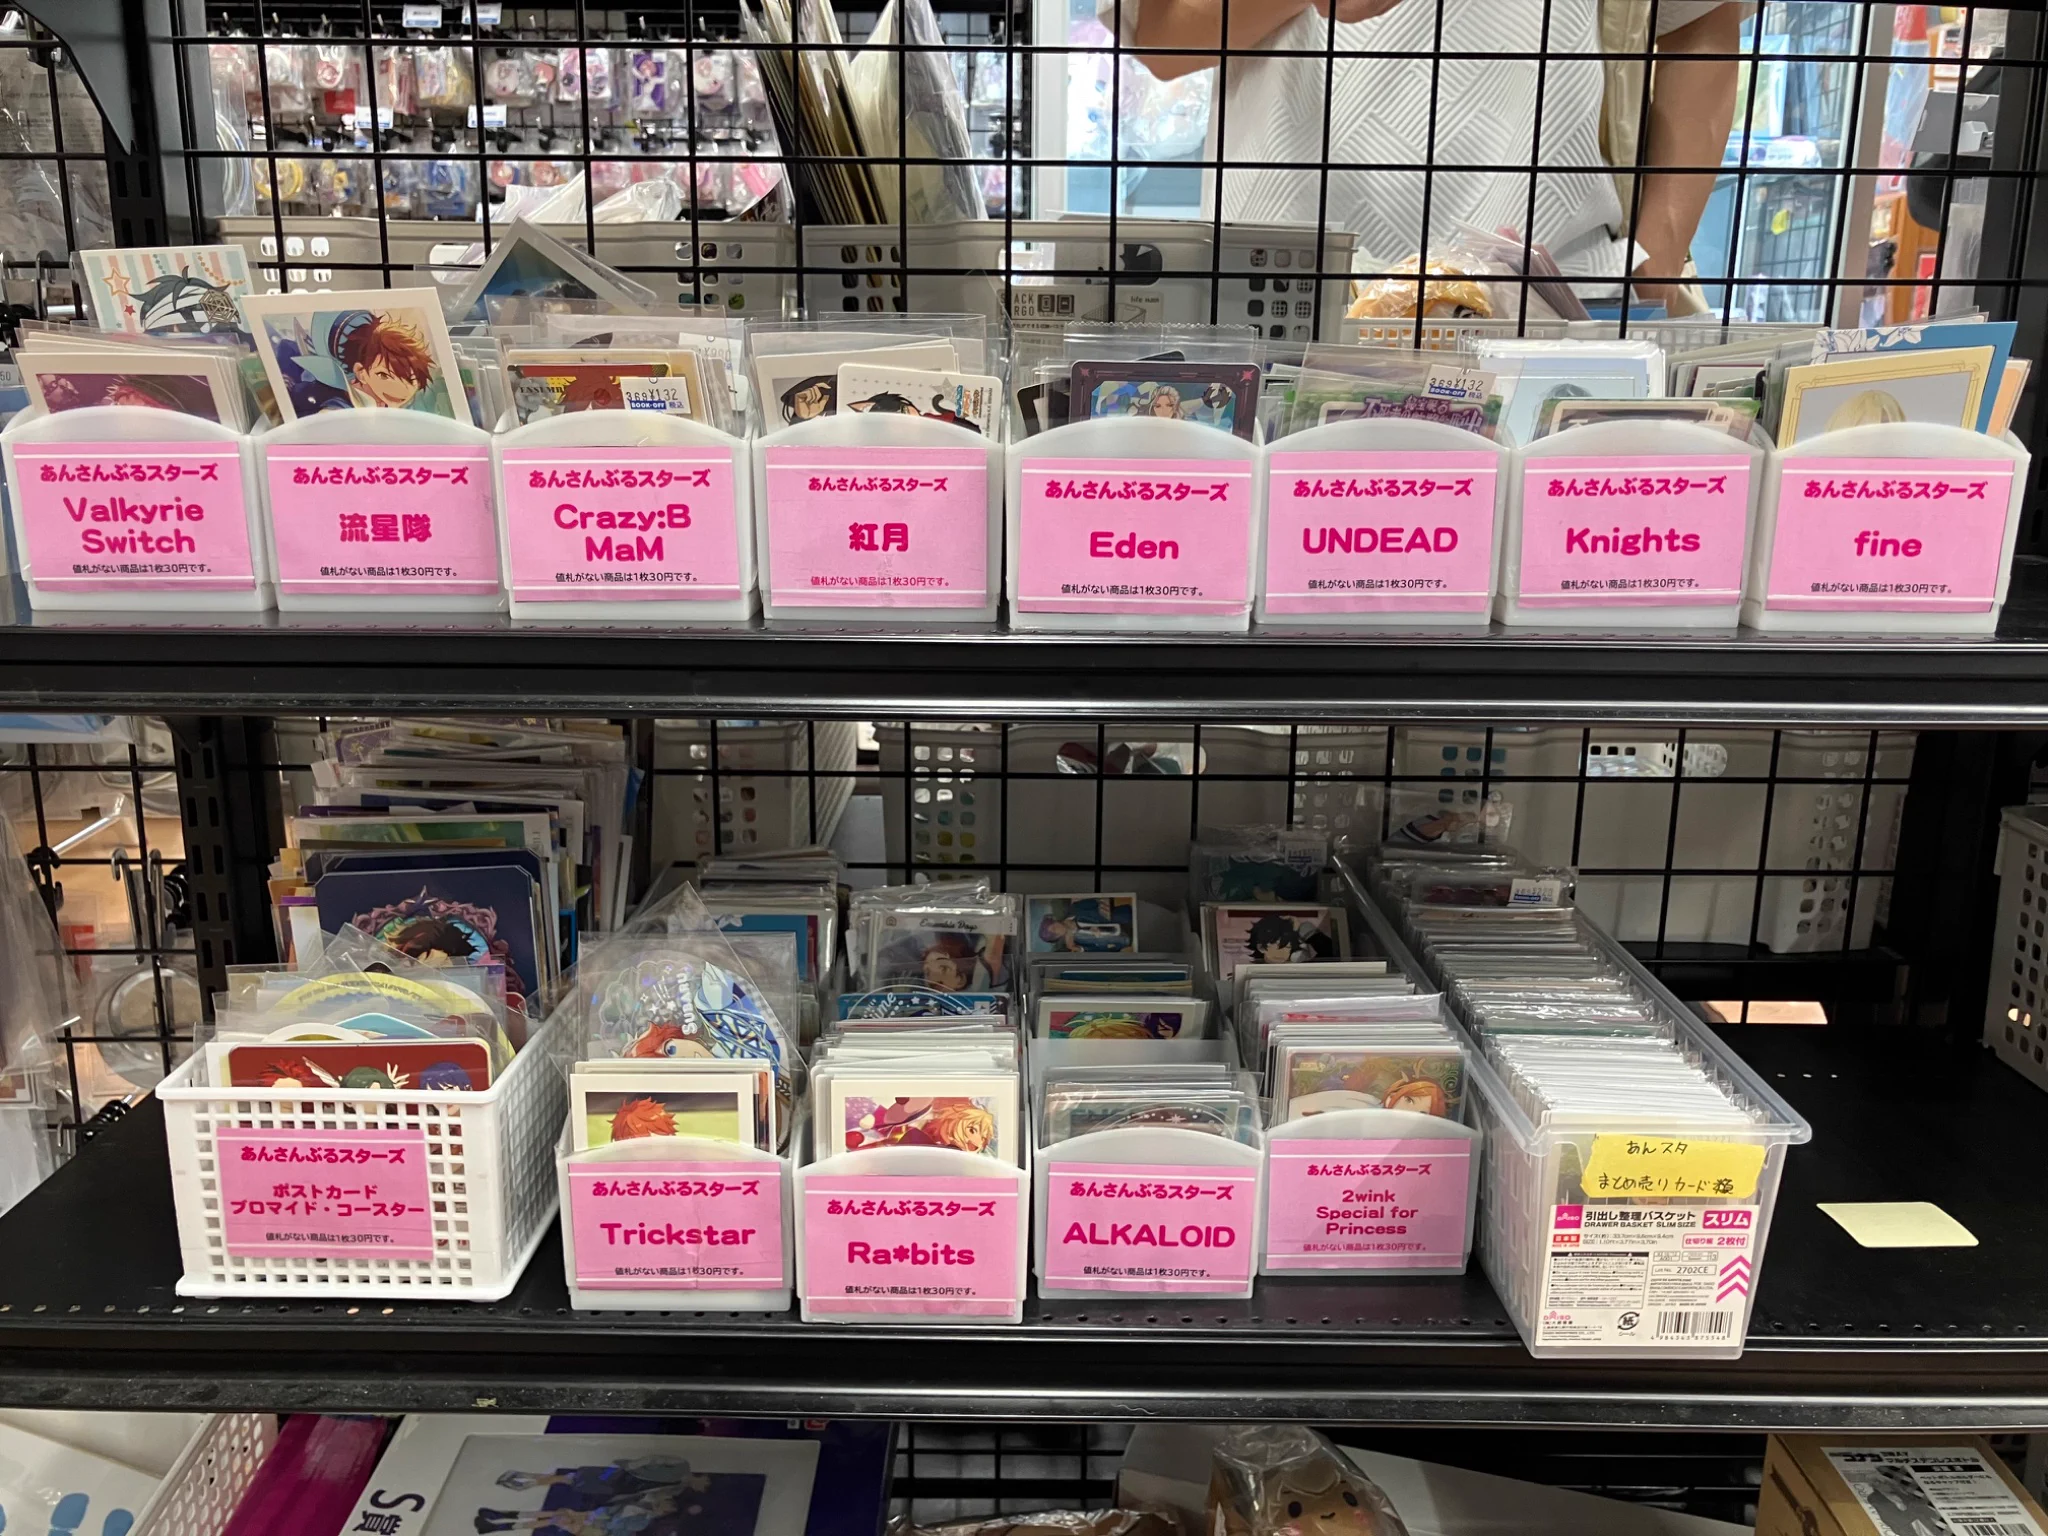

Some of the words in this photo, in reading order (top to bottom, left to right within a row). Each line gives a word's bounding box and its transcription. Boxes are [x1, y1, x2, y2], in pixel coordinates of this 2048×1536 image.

[1000, 292, 1034, 304] SACK
[40, 462, 218, 483] あんさんぶるスターズ
[293, 466, 469, 486] あんさんぶるスターズ
[529, 468, 711, 489] あんさんぶるスターズ
[808, 476, 949, 492] あんさんぶるスターズ
[1044, 479, 1230, 502] あんさんぶるスターズ
[1293, 477, 1474, 498] あんさんぶるスターズ
[1547, 475, 1728, 497] あんさんぶるスターズ
[1803, 479, 1989, 500] あんさんぶるスターズ
[62, 496, 205, 525] Valkyrie
[553, 503, 692, 532] Crazy:B
[339, 512, 433, 543] 流星隊
[81, 528, 196, 554] Switch
[848, 521, 909, 553] 紅月
[1089, 531, 1179, 560] Eden
[1302, 526, 1459, 554] UNDEAD
[1566, 526, 1701, 556] Knights
[1853, 530, 1923, 558] fine
[585, 535, 664, 562] MaM
[72, 563, 212, 574] 値札がない商品は1枚30円です。
[319, 566, 458, 577] 値札がない商品は1枚30円です。
[555, 571, 698, 583] 値札がない商品は1枚30円です。
[810, 575, 950, 587] 値札がない商品は1枚30円です。
[1060, 583, 1203, 597] 値札がない商品は1枚30円です。
[1307, 578, 1448, 590] 値札がない商品は1枚30円です。
[1560, 578, 1700, 590] 値札がない商品は1枚30円です。
[1810, 582, 1952, 594] 値札がない商品は1枚30円です。
[675, 971, 699, 1036] SUBARU
[240, 1145, 406, 1165] あんさんぶるスターズ
[1626, 1140, 1688, 1155] あんスタ
[1307, 1163, 1433, 1177] あんさんぶるスターズ
[272, 1182, 378, 1200] ポストカード
[592, 1179, 760, 1198] あんさんぶるスターズ
[1069, 1181, 1234, 1201] あんさんぶるスターズ
[1342, 1189, 1396, 1203] 2wink
[230, 1199, 425, 1217] ブロマイド・コースター
[826, 1199, 997, 1217] あんさんぶるスターズ
[1316, 1205, 1385, 1221] Special
[1390, 1205, 1419, 1219] for
[1586, 1211, 1697, 1221] 引出し整理バスケット
[1325, 1222, 1407, 1235] Princess
[1704, 1212, 1750, 1227] スリム
[265, 1232, 395, 1244] 値札がない商品は1枚30円です。
[599, 1222, 757, 1246] Trickstar
[1062, 1221, 1236, 1248] ALKALOID
[1717, 1236, 1746, 1246] 2枚付
[614, 1265, 744, 1276] 値札がない商品は1枚30円です。
[1083, 1265, 1211, 1278] 値札がない商品は1枚30円です。
[1676, 1266, 1709, 1274] 2702CE
[844, 1285, 976, 1296] 値札がない商品は1枚30円です。
